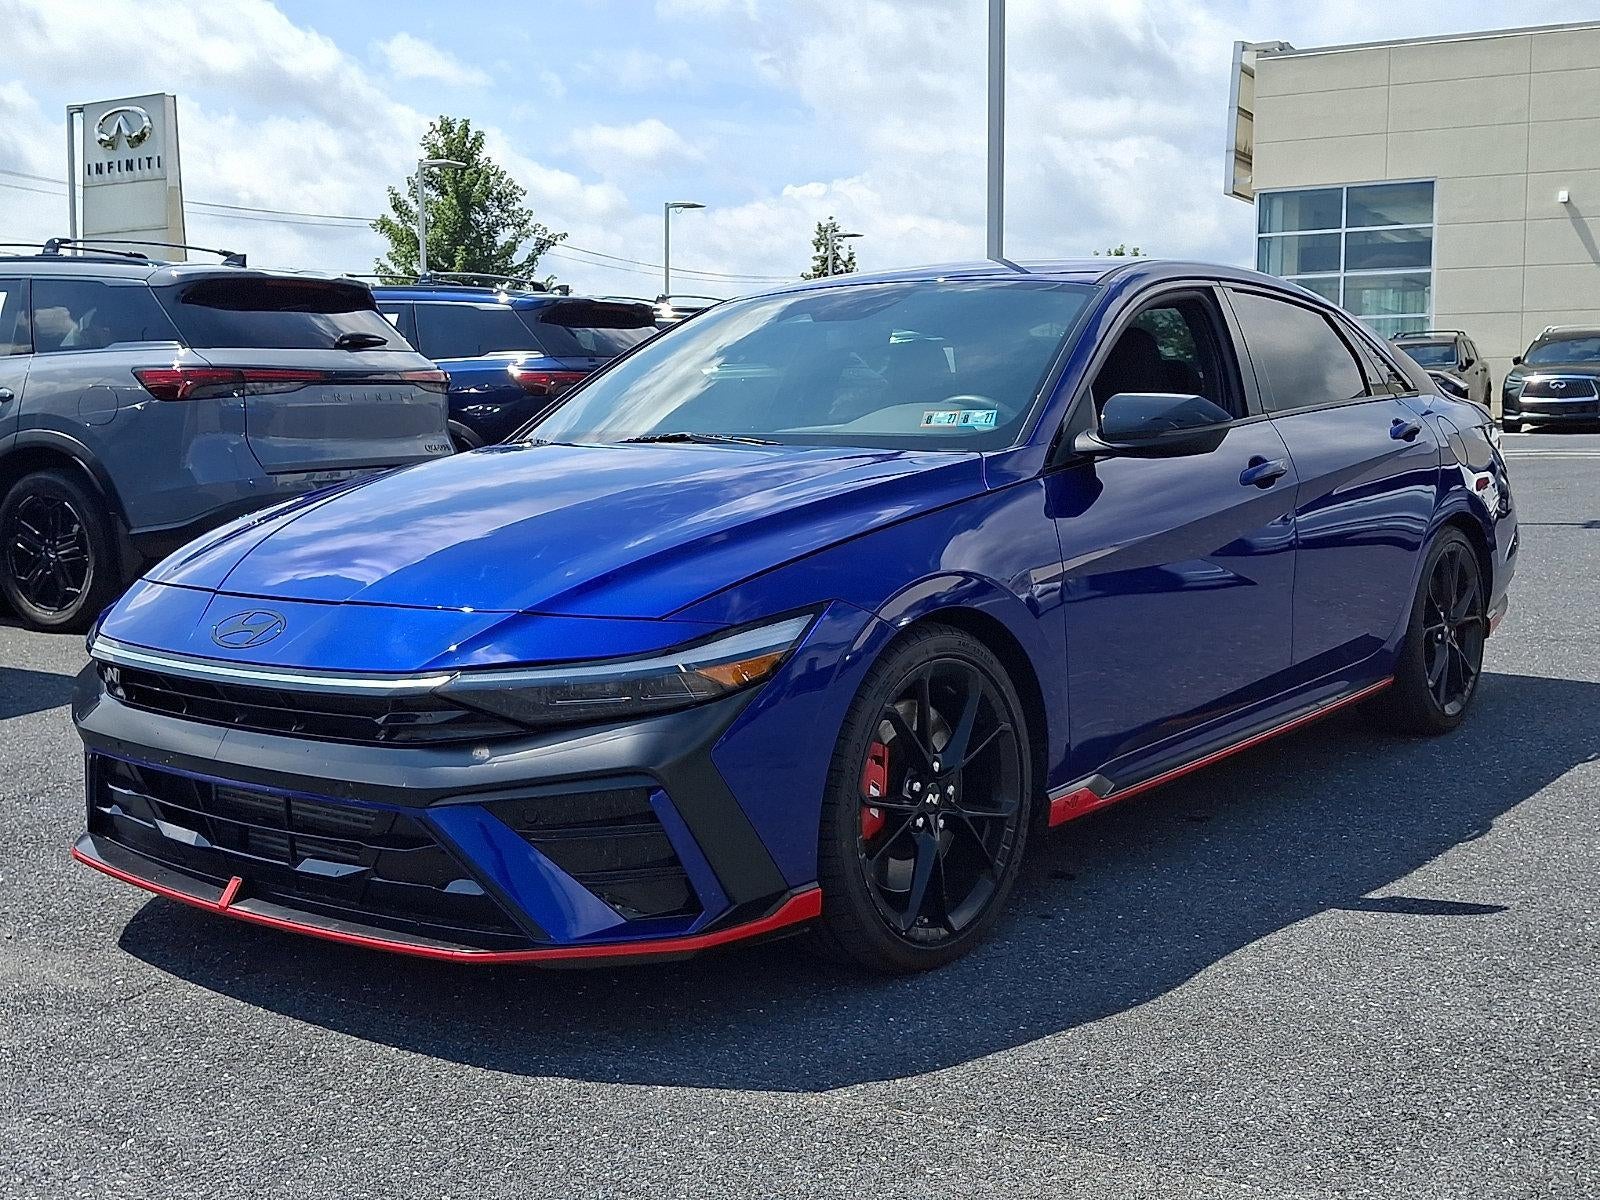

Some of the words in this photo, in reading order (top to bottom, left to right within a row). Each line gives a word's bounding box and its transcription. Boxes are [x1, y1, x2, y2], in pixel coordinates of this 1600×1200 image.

[87, 155, 161, 176] INFINITI
[947, 413, 957, 423] 27
[985, 412, 994, 423] 27
[926, 793, 940, 805] N
